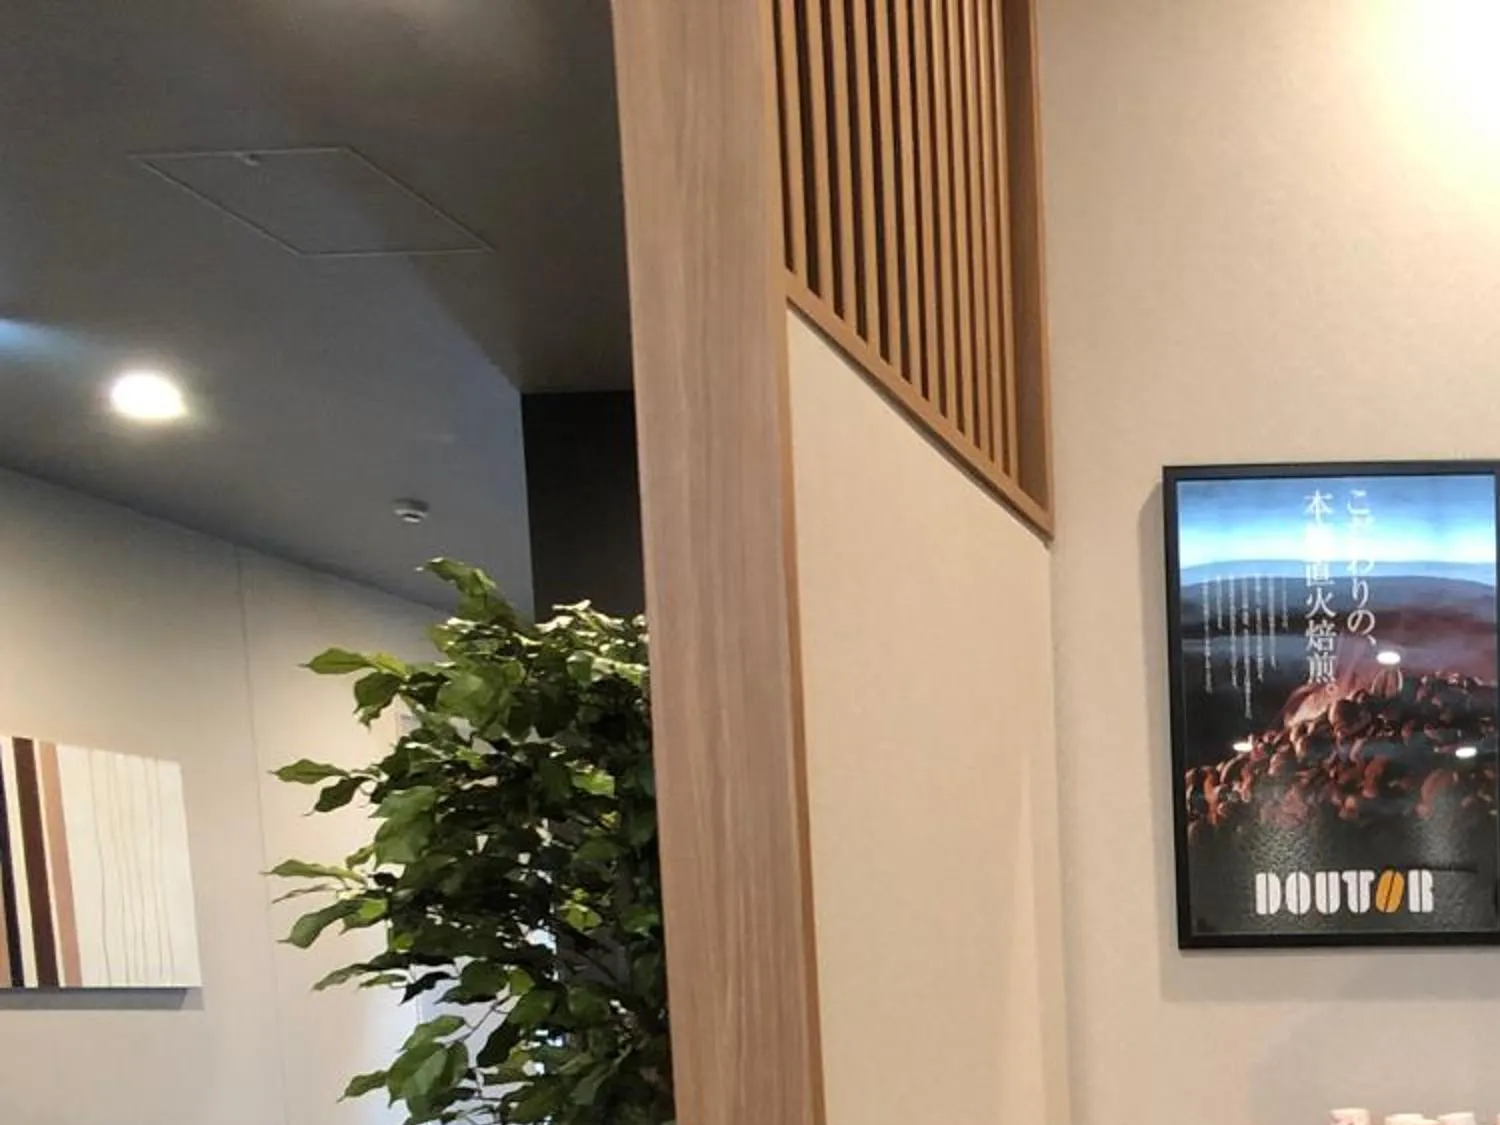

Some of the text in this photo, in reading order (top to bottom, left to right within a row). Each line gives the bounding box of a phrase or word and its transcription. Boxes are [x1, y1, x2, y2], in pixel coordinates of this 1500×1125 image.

[1302, 488, 1338, 691] 本直火焙煎。
[1346, 488, 1377, 647] こわりの、
[1255, 869, 1435, 916] DOUTOR
